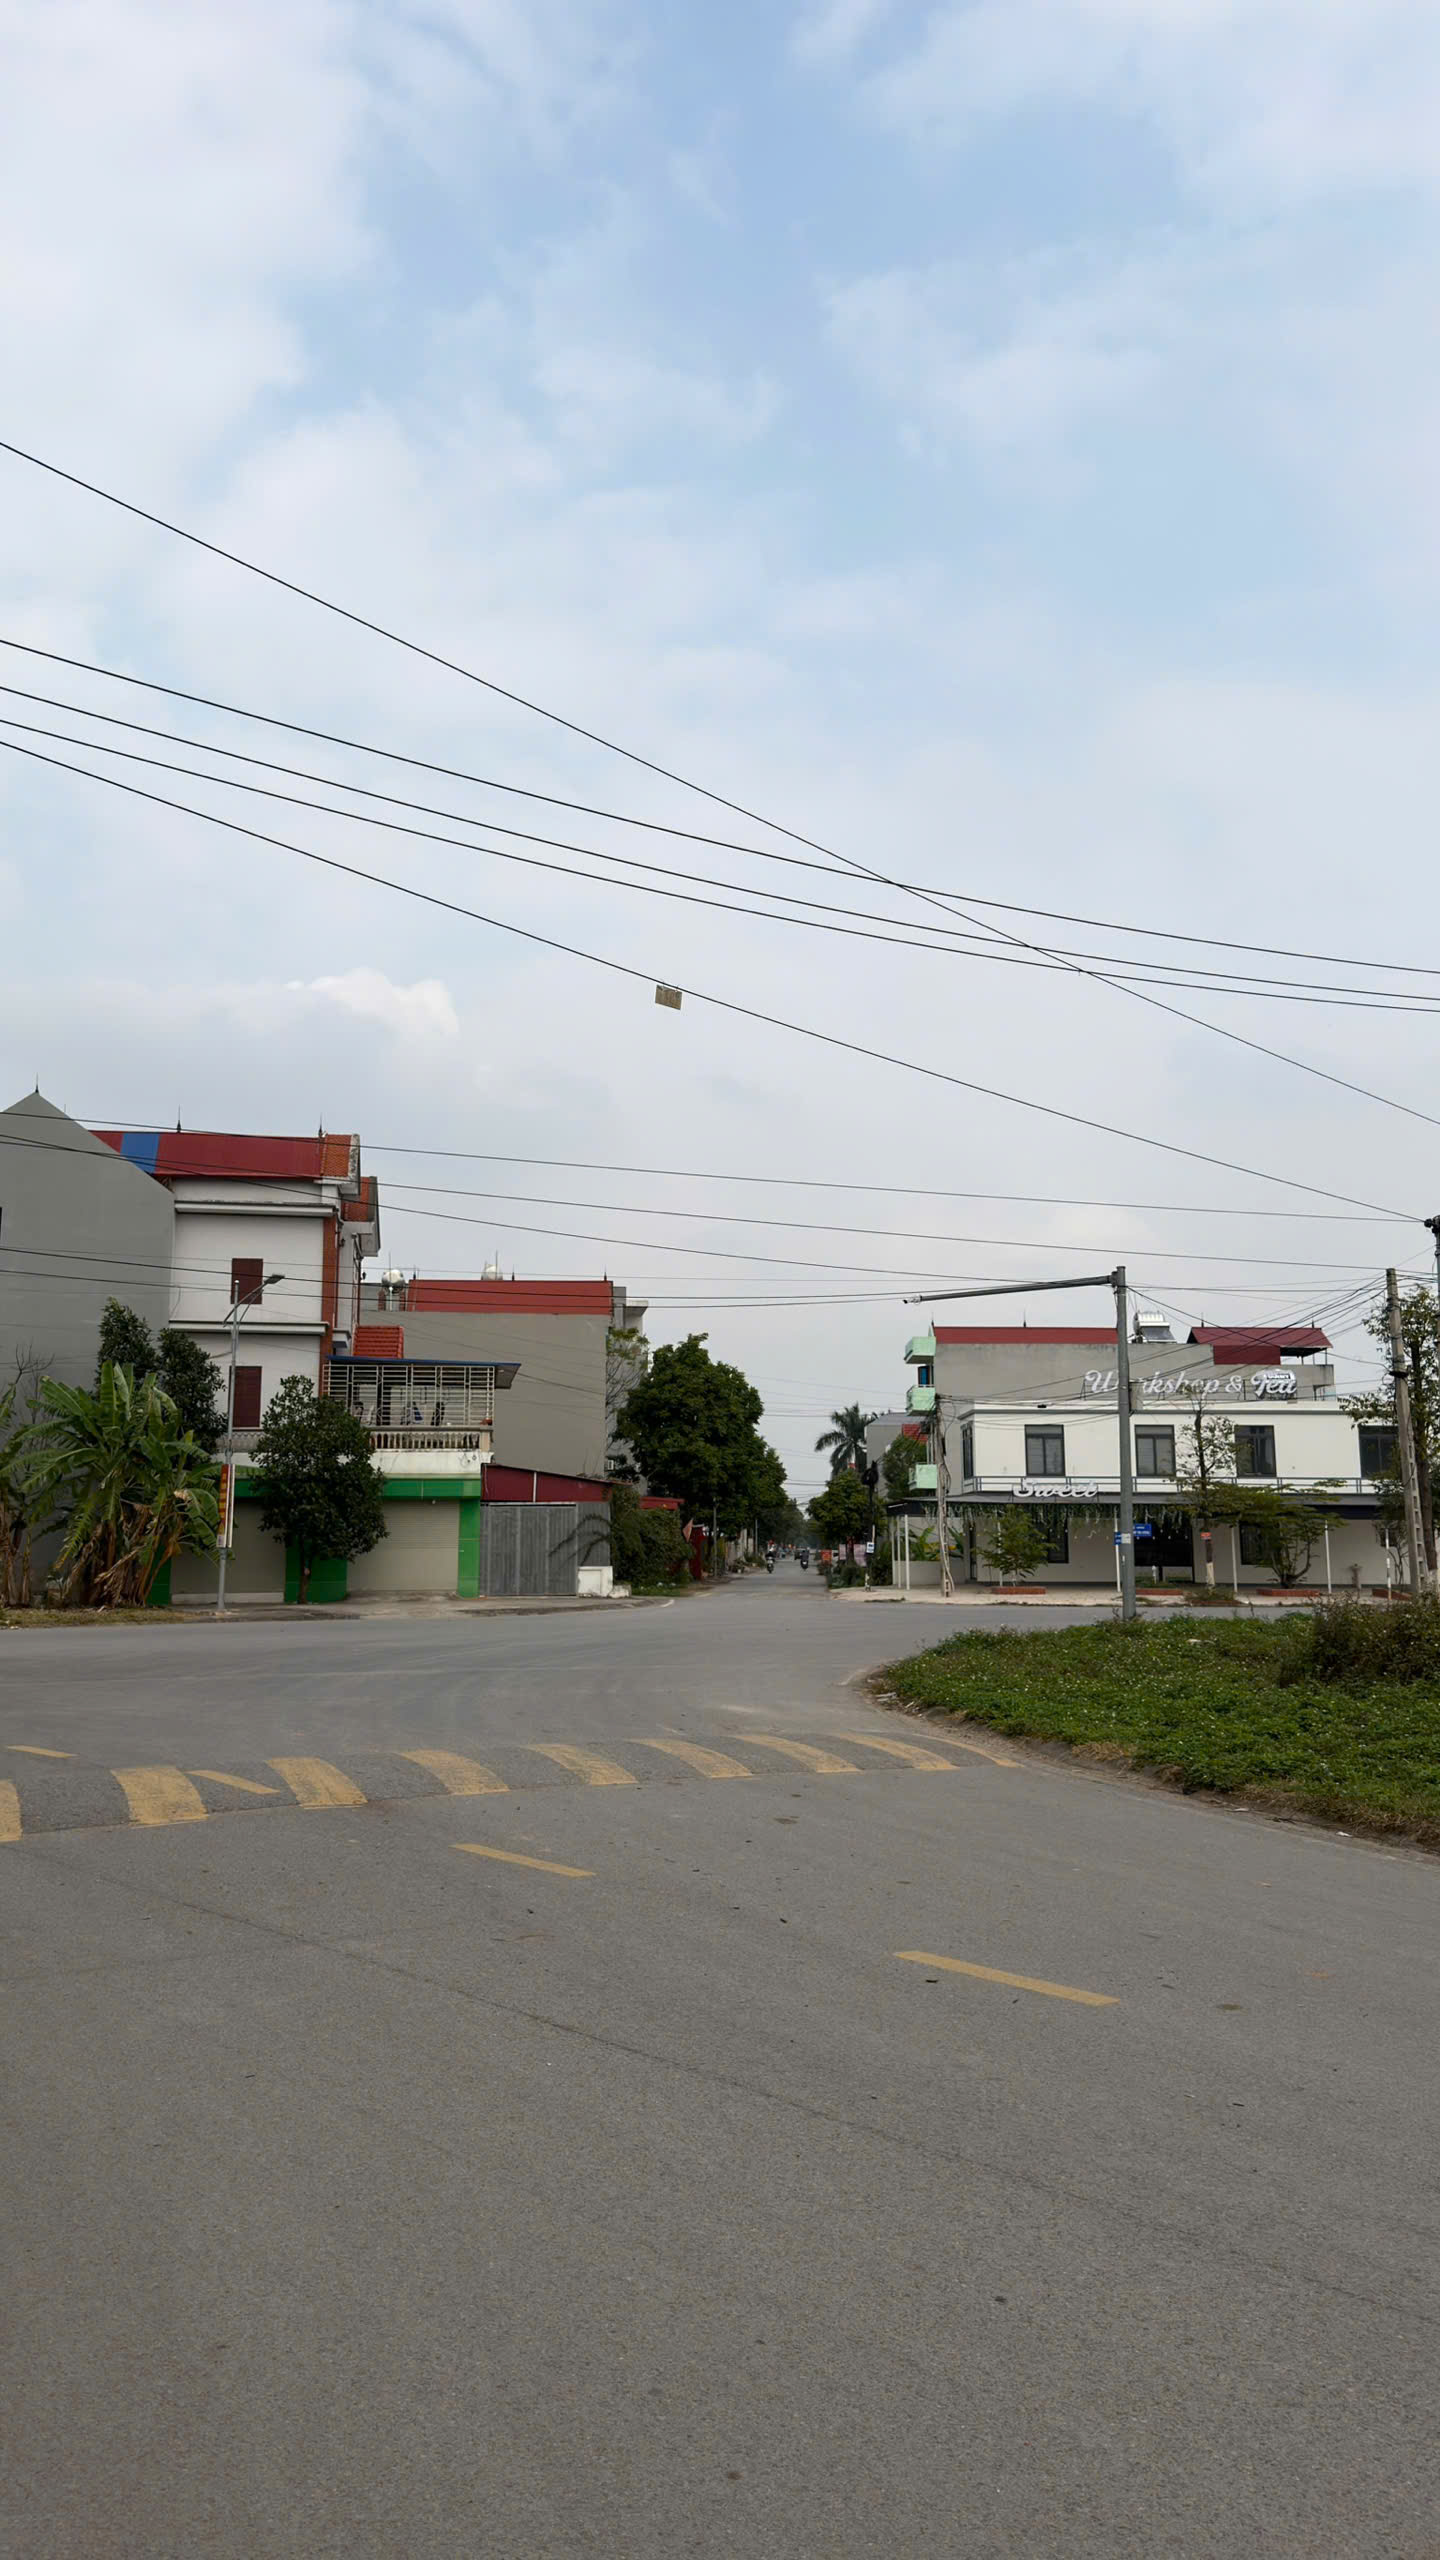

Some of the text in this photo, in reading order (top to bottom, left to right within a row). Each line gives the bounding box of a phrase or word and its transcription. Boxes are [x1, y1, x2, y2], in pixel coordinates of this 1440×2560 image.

[1085, 1368, 1297, 1400] Wkshop & Tea
[1012, 1478, 1098, 1498] Sweet
